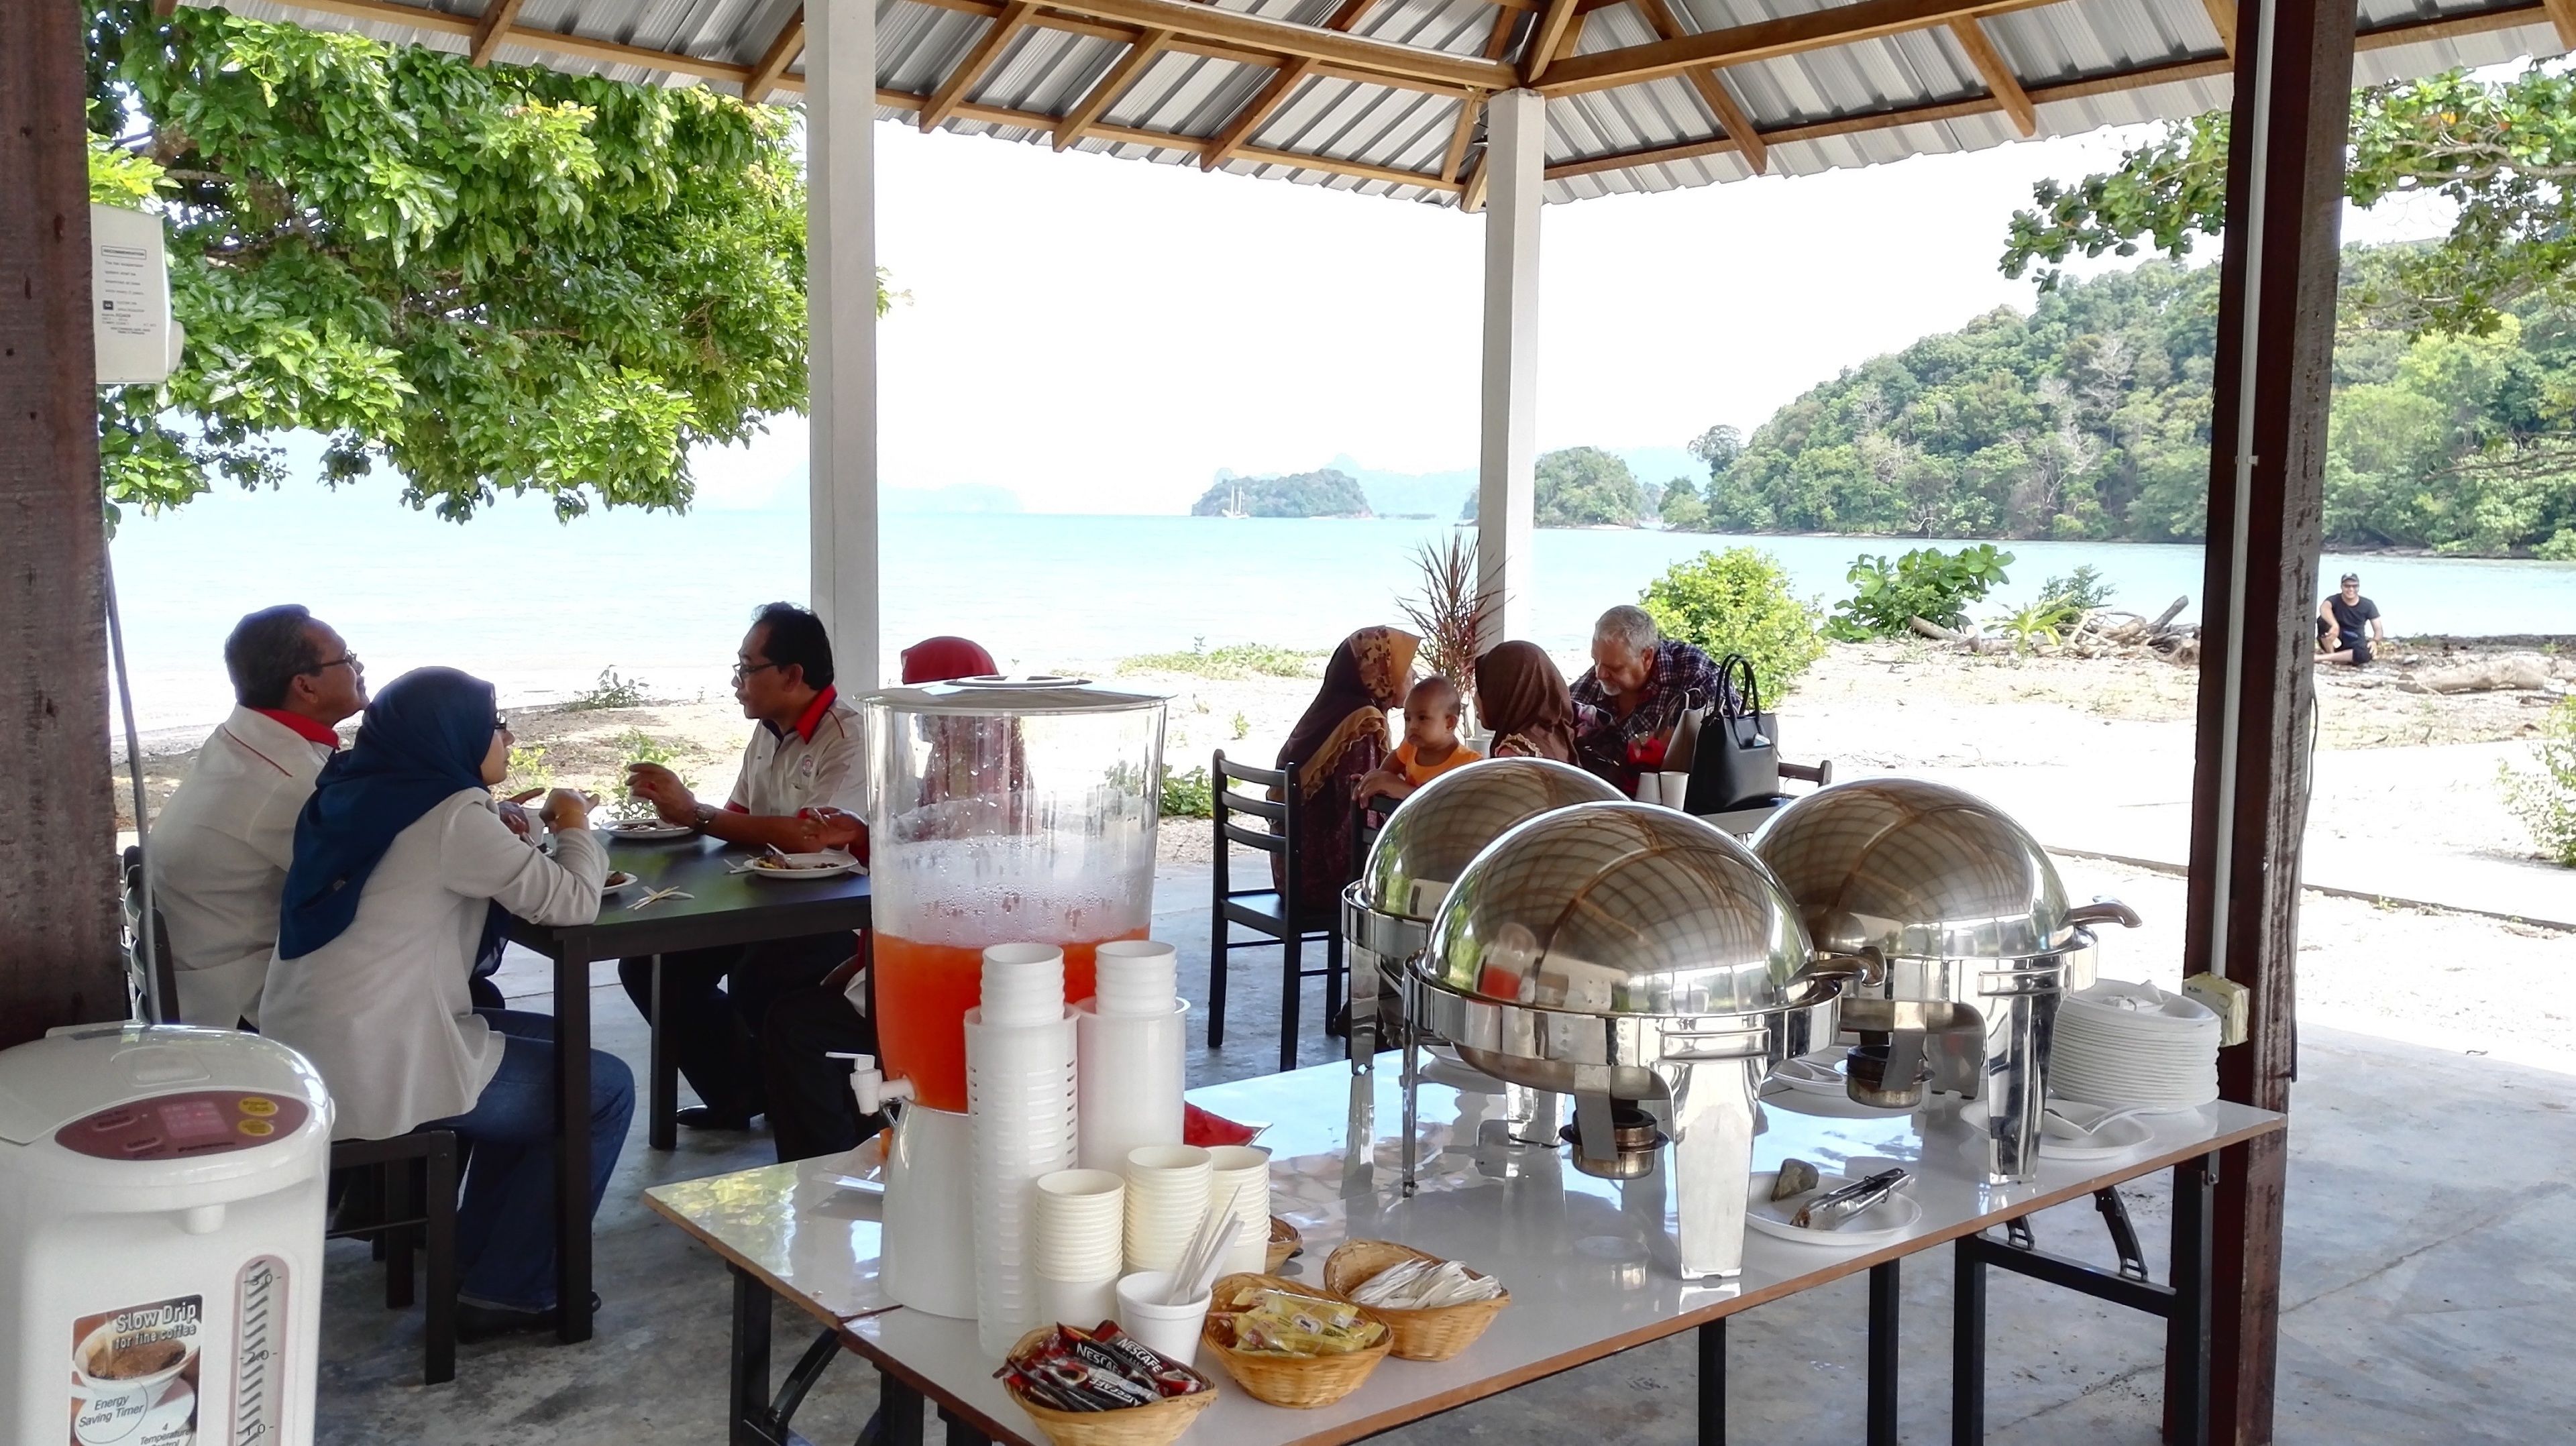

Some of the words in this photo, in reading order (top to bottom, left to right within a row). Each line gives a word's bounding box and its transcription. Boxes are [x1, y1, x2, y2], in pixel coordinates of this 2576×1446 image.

[116, 1311, 159, 1333] Slow
[163, 1302, 197, 1324] Drip
[115, 1337, 132, 1350] for
[136, 1331, 158, 1346] fine
[161, 1323, 197, 1340] coffee
[95, 1395, 130, 1411] Energy
[78, 1412, 112, 1428] Saving
[116, 1404, 145, 1419] Timer
[162, 1423, 168, 1431] 4
